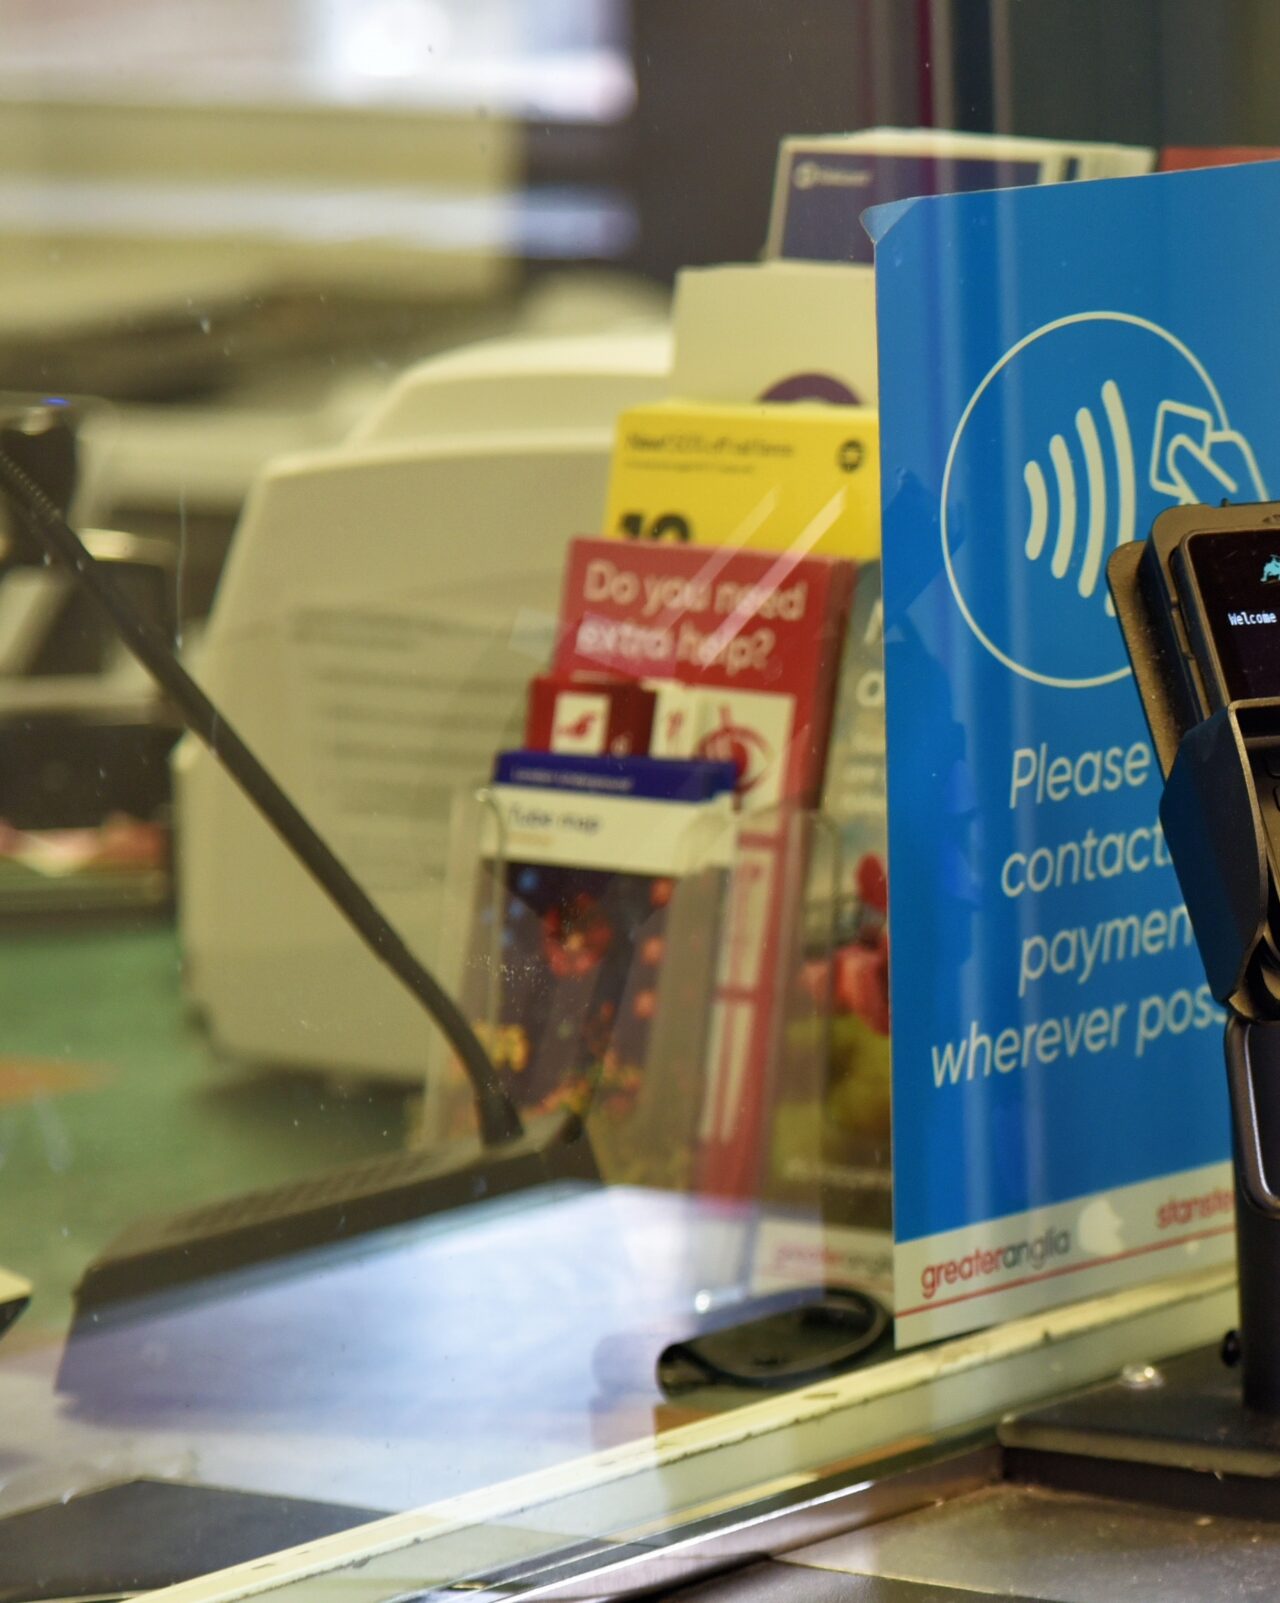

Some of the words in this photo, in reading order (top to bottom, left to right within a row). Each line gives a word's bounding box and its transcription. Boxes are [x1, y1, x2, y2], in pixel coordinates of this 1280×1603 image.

[583, 558, 640, 605] Do
[641, 574, 712, 618] you
[714, 580, 808, 621] need
[1228, 609, 1277, 626] Welcome
[675, 619, 776, 678] help?
[1009, 742, 1150, 809] Please
[1001, 815, 1173, 898] contact
[1018, 903, 1193, 998] paymen
[931, 1020, 1128, 1089] wherever
[1135, 982, 1227, 1058] pos
[921, 1226, 1070, 1299] greateranglia
